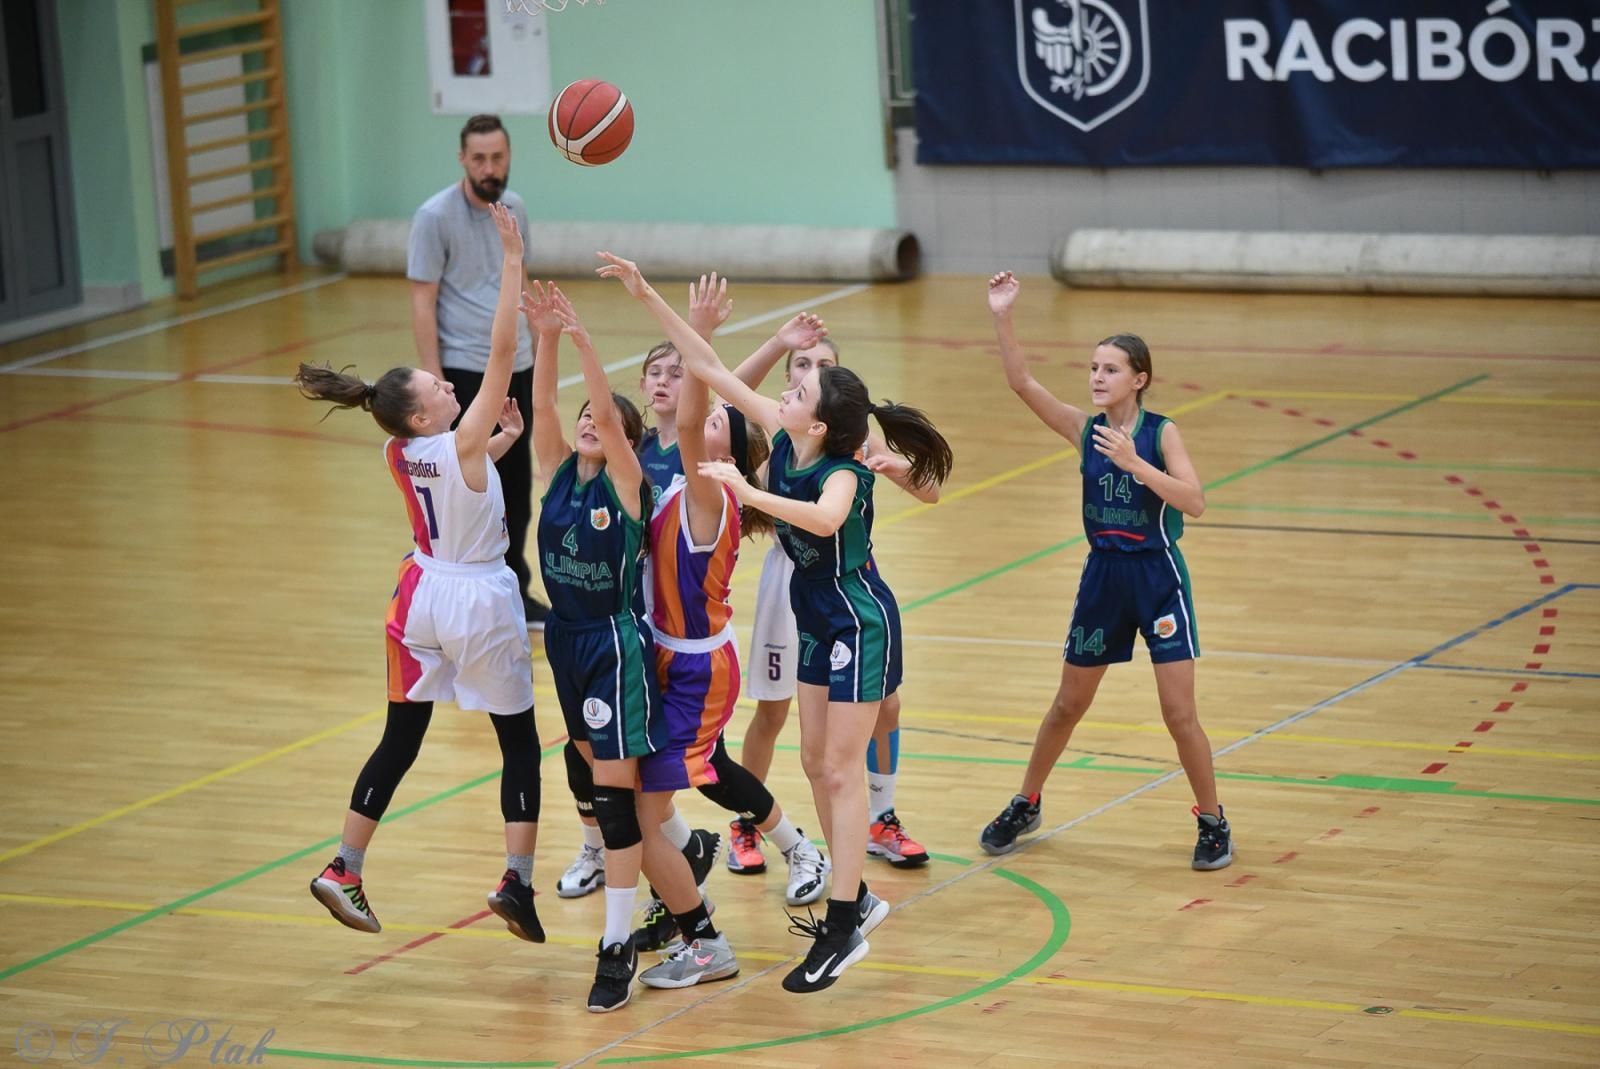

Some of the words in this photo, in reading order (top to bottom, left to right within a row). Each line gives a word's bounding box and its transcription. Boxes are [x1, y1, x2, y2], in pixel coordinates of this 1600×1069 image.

[1223, 0, 1600, 82] RACIBÓR
[1098, 472, 1133, 503] 14
[1085, 503, 1149, 526] OLIMPIA
[562, 523, 579, 556] 4
[1071, 625, 1107, 657] 14
[768, 652, 781, 681] 5
